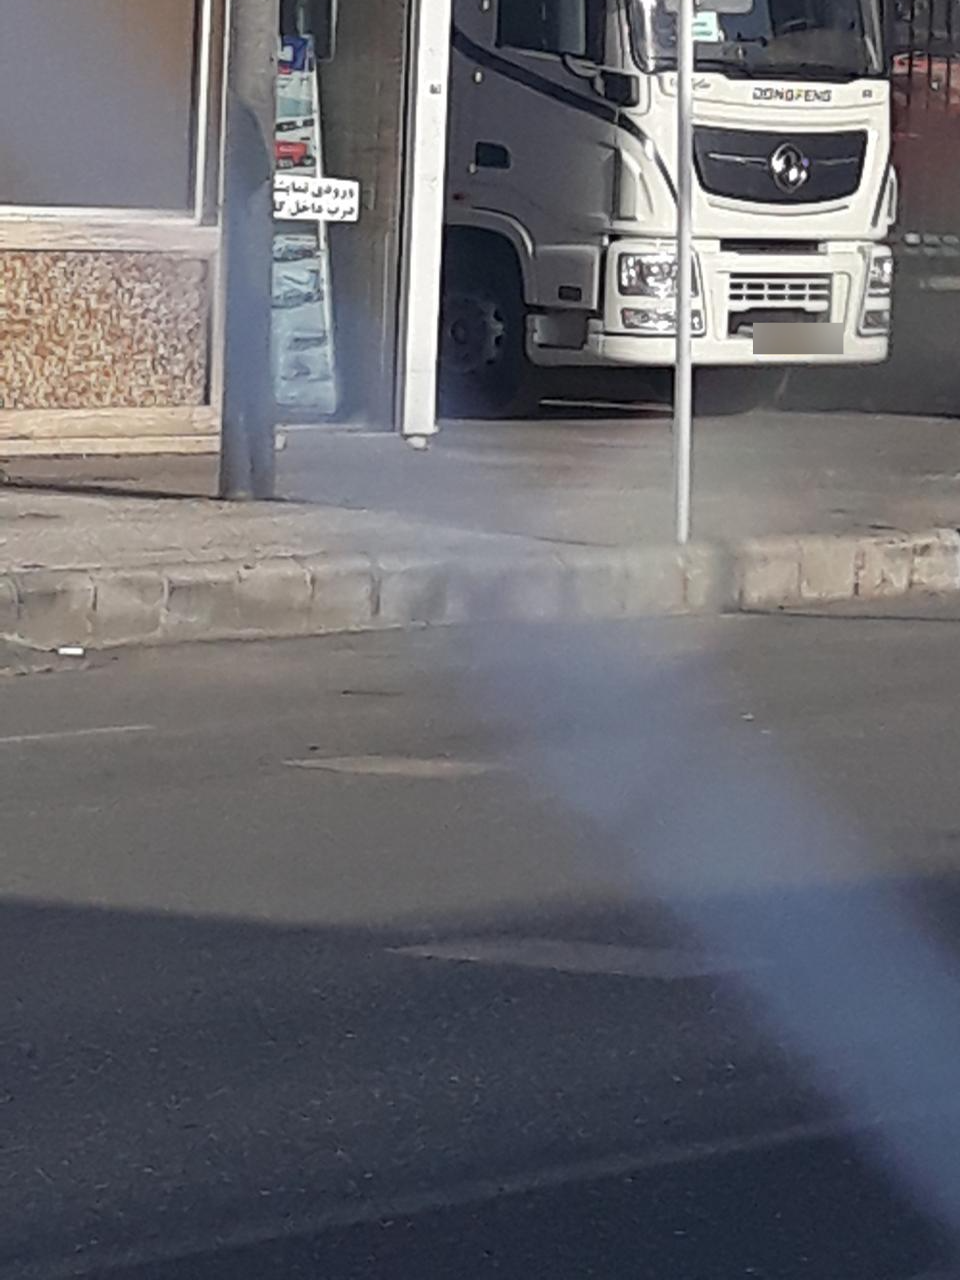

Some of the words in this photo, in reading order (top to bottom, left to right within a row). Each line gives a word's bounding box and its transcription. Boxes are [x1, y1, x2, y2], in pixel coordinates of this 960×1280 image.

[752, 87, 832, 102] DONGFENG
[311, 184, 355, 200] ورودی
[290, 200, 323, 216] داخل
[326, 206, 355, 219] درب
